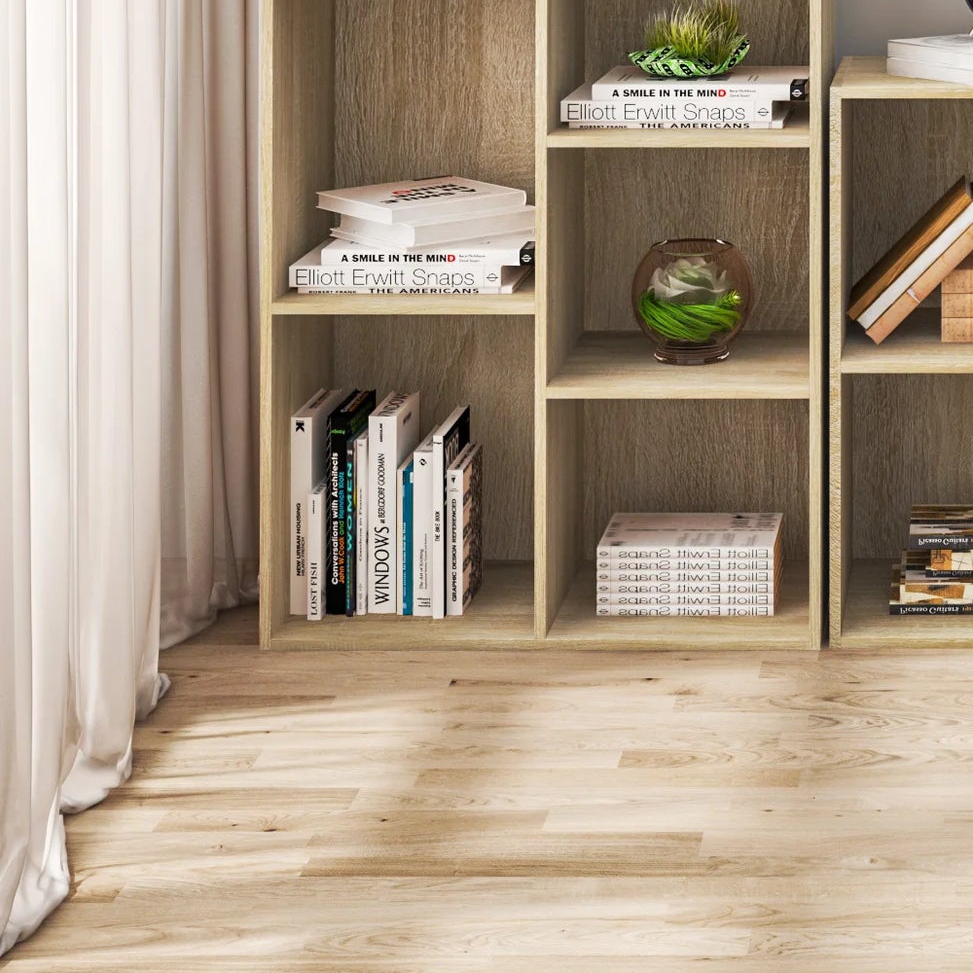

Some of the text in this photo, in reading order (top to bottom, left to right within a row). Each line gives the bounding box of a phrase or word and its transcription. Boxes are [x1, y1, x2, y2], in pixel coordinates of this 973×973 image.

[612, 89, 619, 97] A
[623, 89, 655, 97] SMILE
[659, 89, 669, 97] IN
[674, 89, 694, 97] THE
[697, 89, 726, 97] MIND
[567, 103, 745, 122] Elliott Erwitt Snaps
[341, 254, 349, 263] A
[352, 254, 385, 263] SMILE
[388, 254, 399, 263] IN
[403, 254, 423, 263] THE
[426, 254, 456, 263] MIND
[296, 268, 475, 288] Elliott Erwitt Snaps
[377, 453, 385, 485] GOODMAN
[377, 487, 385, 518] BERGDORF
[331, 452, 339, 585] Conversations with Architects
[374, 527, 389, 605] WINDOWS
[310, 562, 318, 616] LOST FISH
